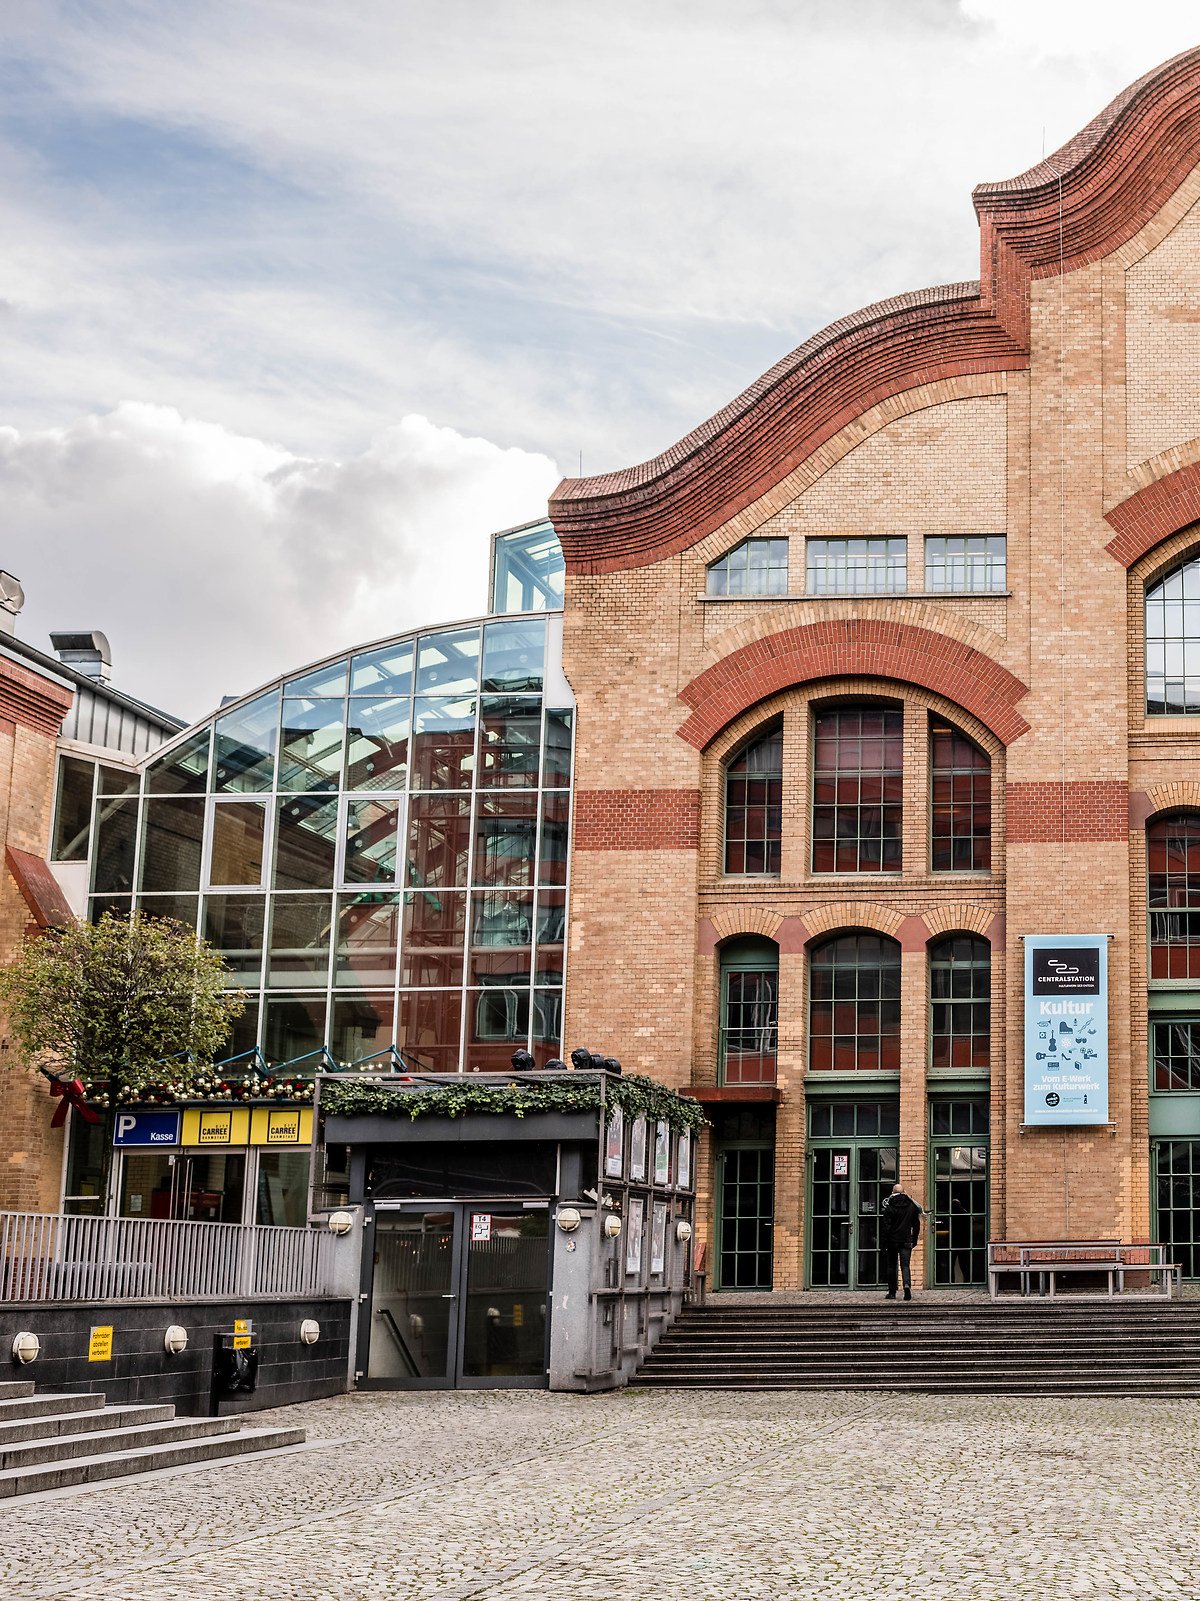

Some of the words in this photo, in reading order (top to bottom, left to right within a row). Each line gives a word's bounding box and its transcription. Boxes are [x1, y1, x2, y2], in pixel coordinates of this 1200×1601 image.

[1040, 1000, 1093, 1015] Kultur
[118, 1116, 136, 1138] P
[150, 1132, 173, 1141] Kasse
